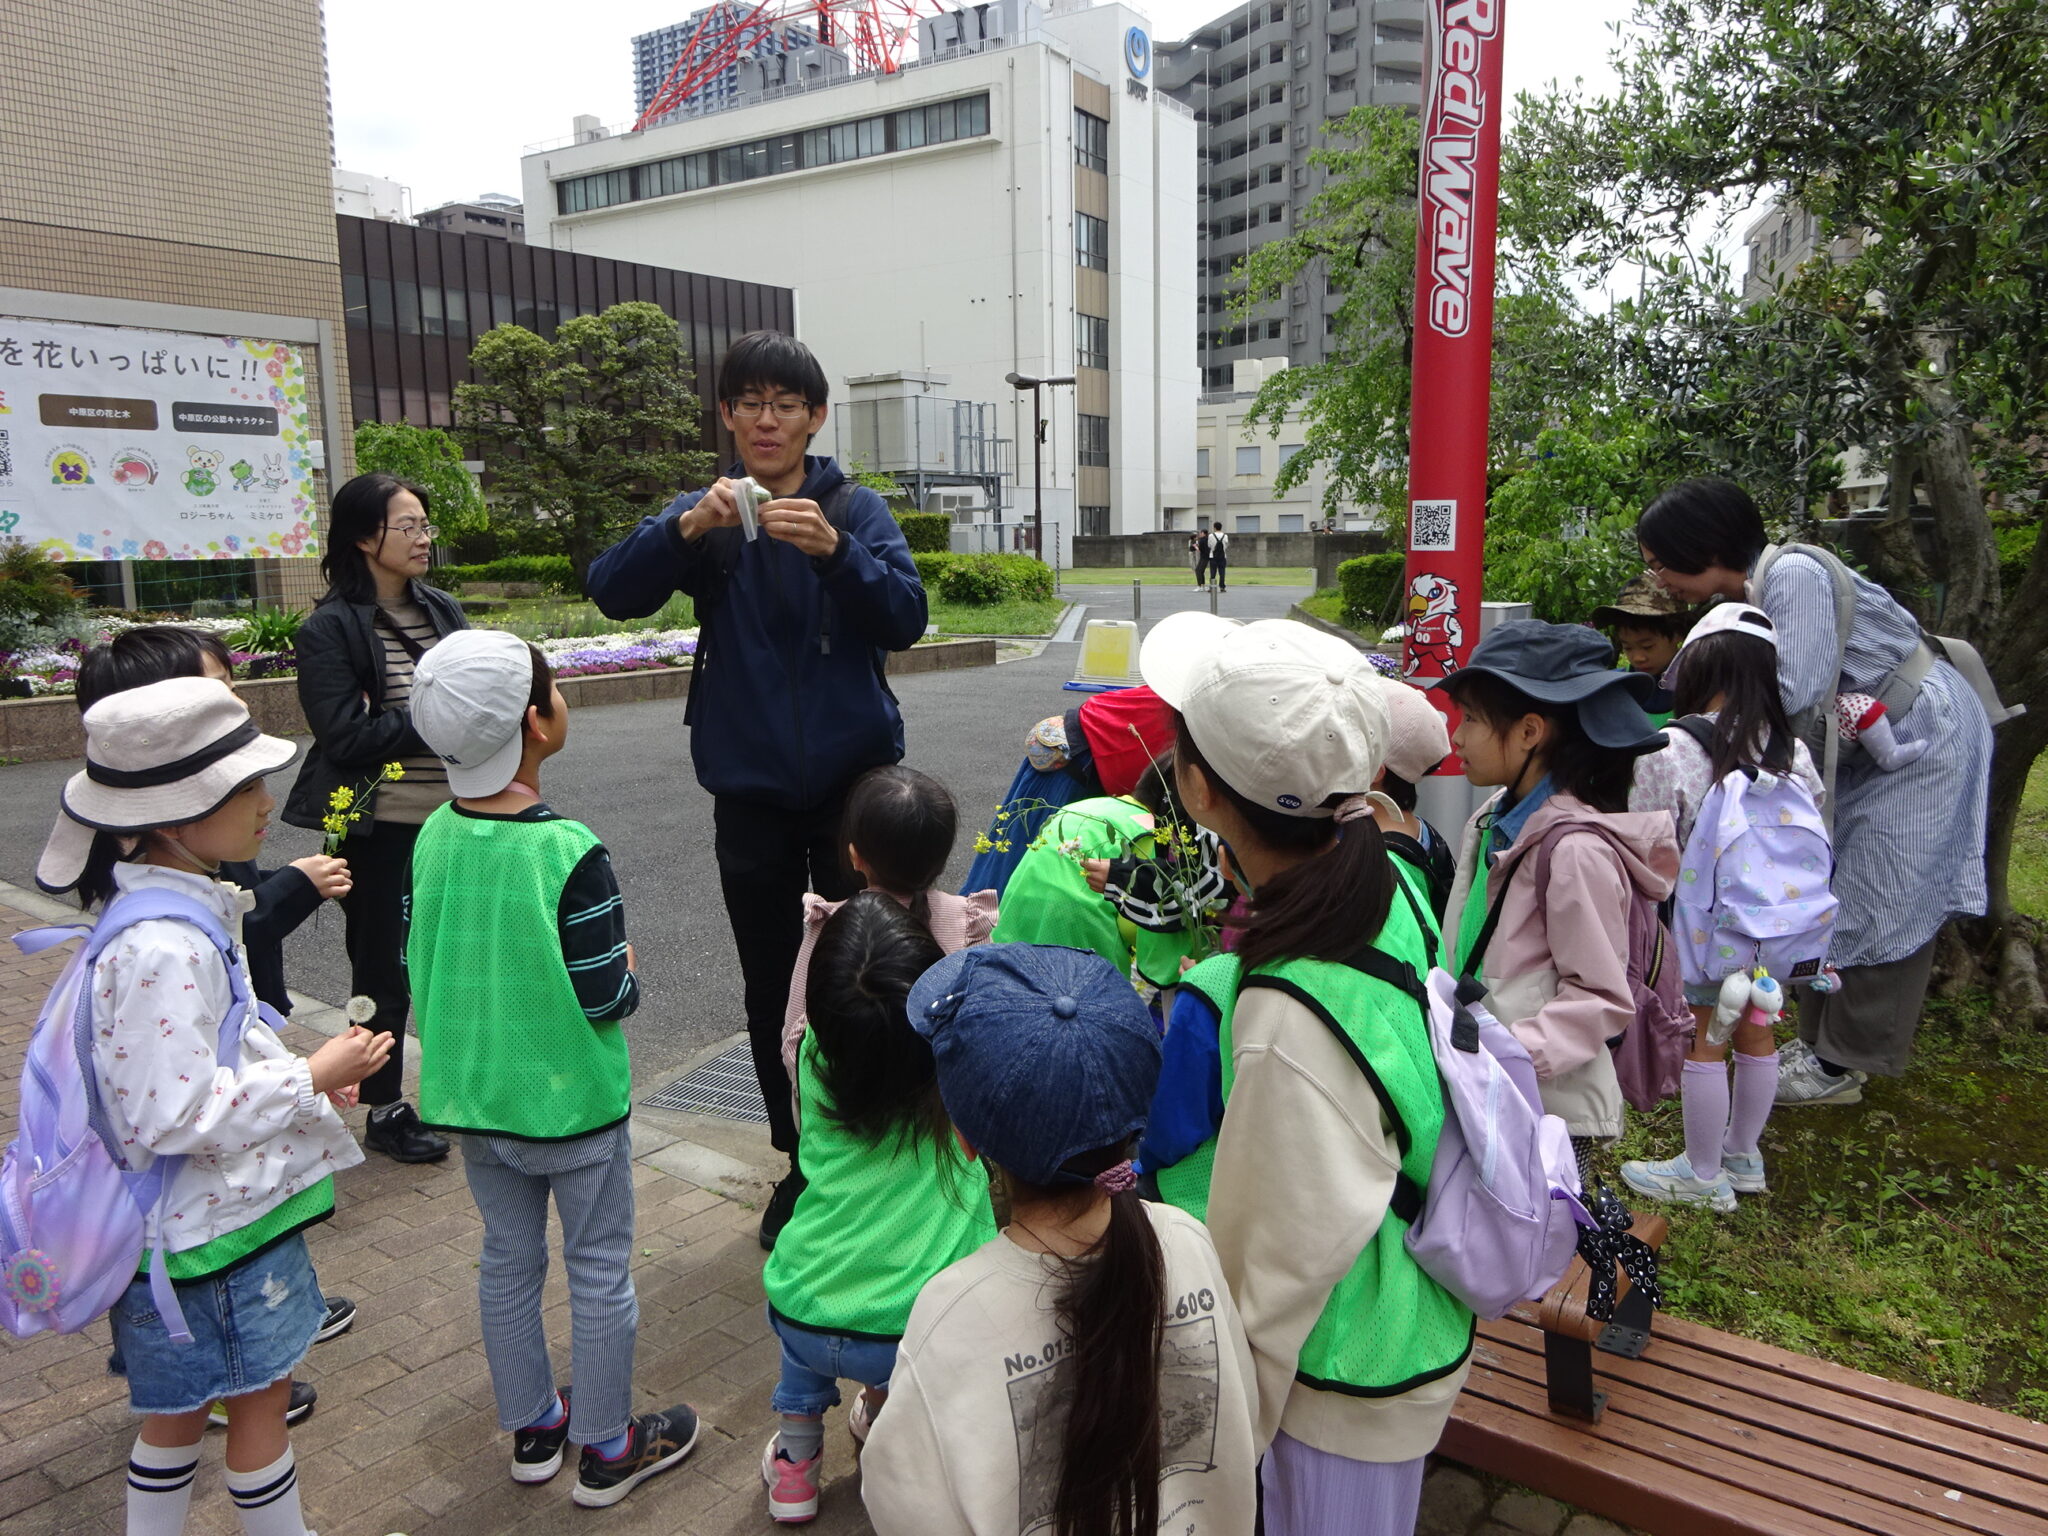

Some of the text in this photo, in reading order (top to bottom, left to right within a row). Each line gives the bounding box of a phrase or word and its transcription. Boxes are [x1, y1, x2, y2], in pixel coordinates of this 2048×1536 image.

[1430, 136, 1473, 333] Wave
[69, 407, 131, 419] 中原区の花と木
[178, 413, 273, 426] 中原区の公認キャラクター
[180, 511, 235, 520] ロジーちゃん
[250, 511, 283, 520] ミミケロ
